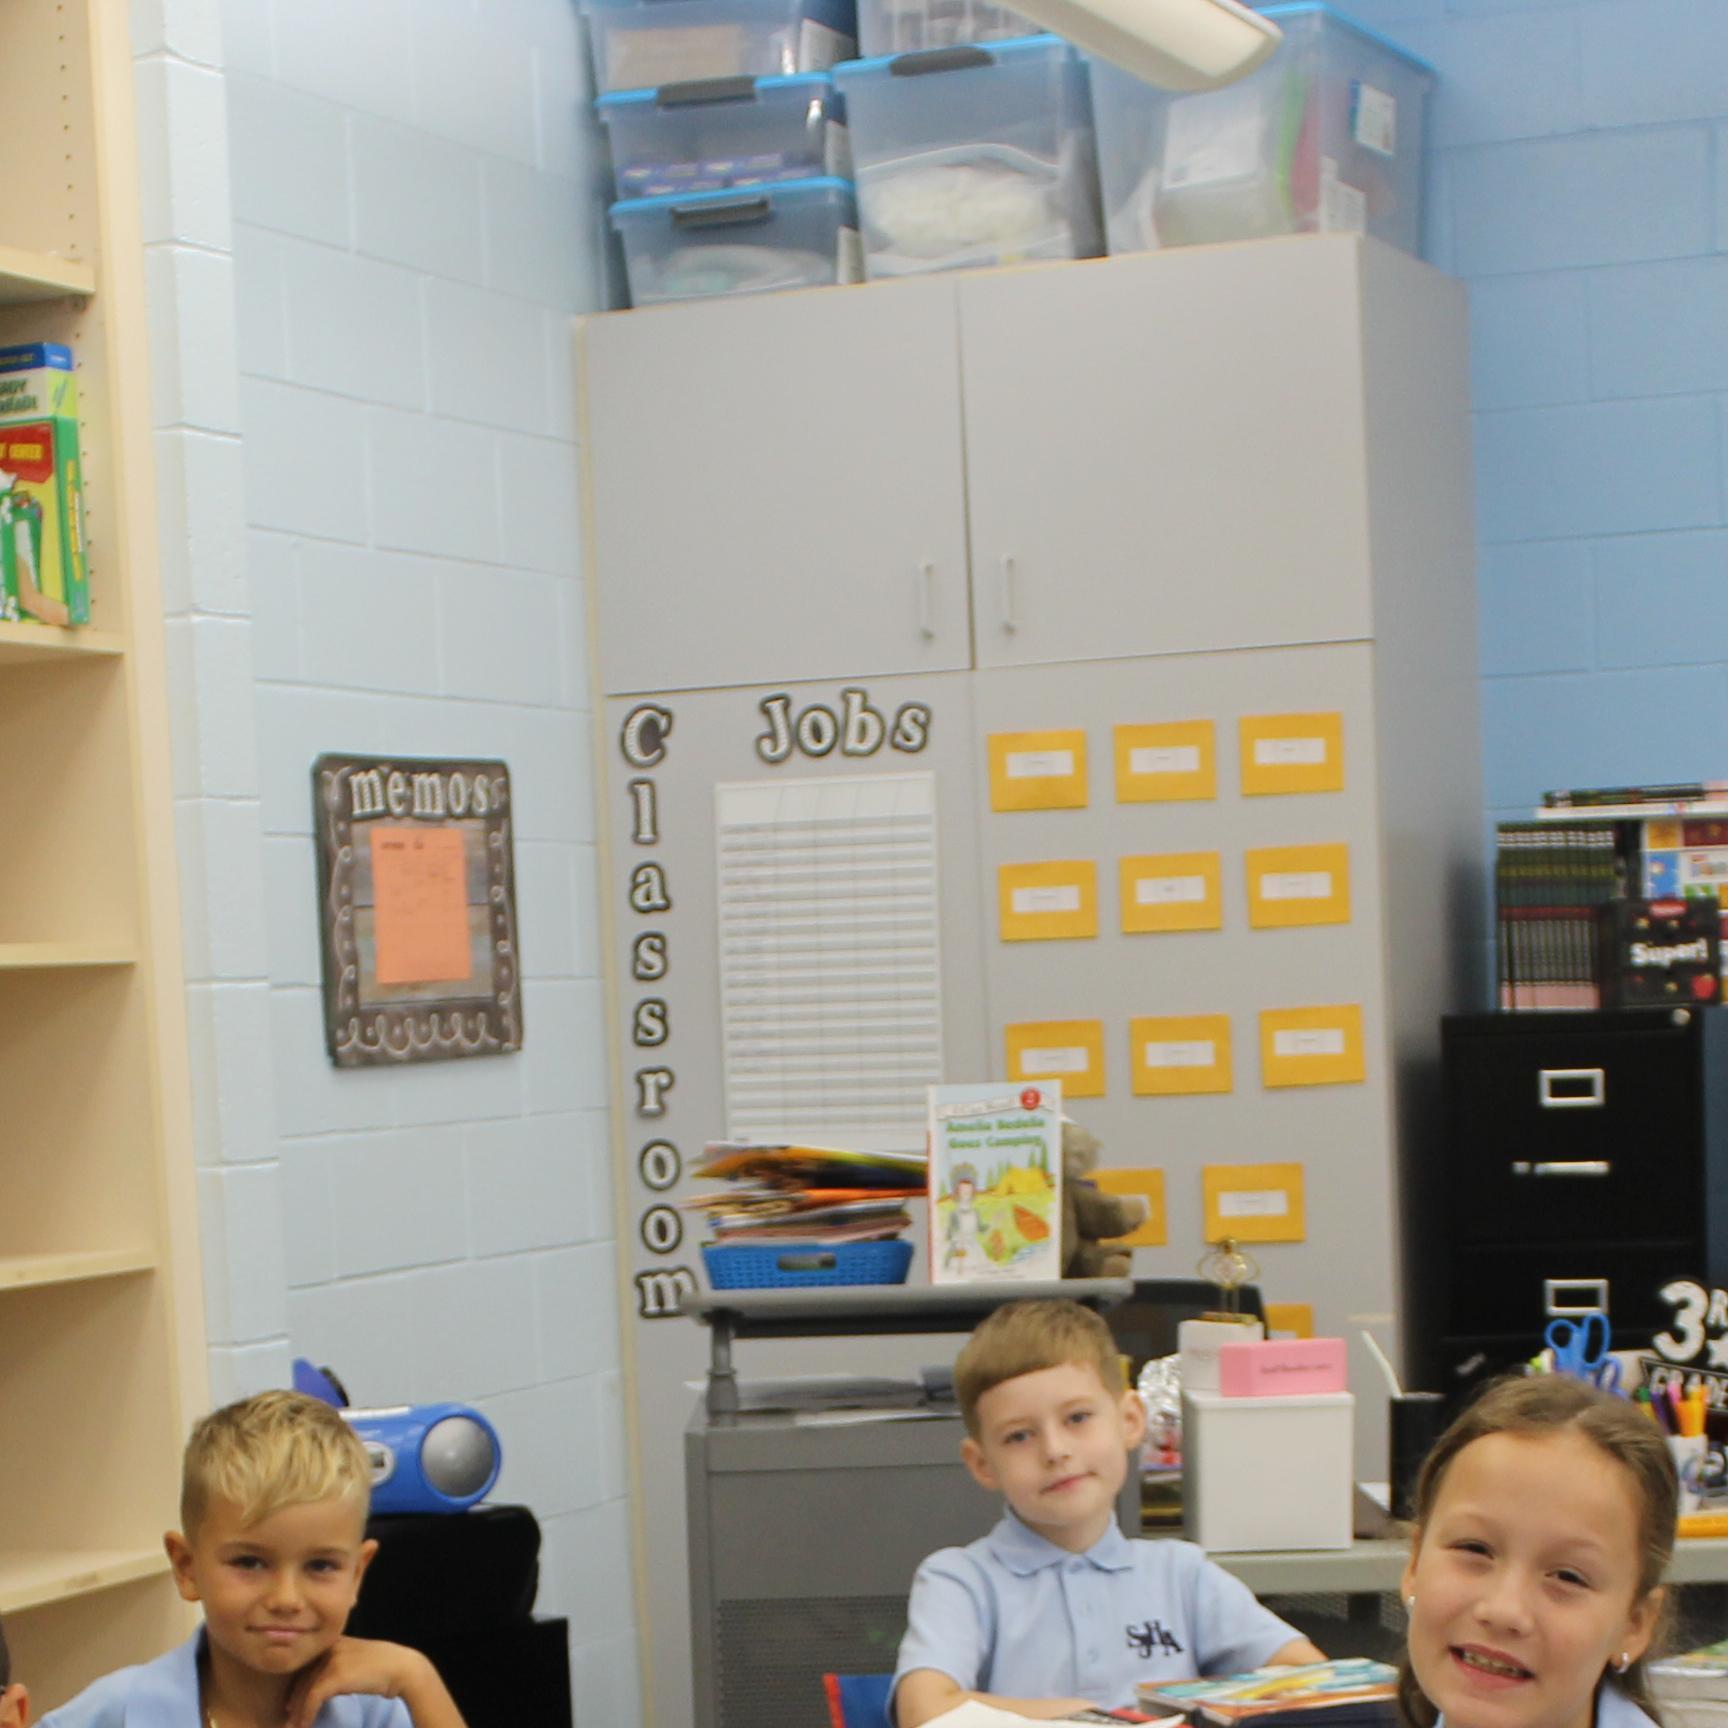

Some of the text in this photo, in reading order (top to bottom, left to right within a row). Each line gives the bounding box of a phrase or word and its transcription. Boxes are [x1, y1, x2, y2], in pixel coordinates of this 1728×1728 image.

[755, 687, 932, 766] Jobs
[348, 769, 493, 821] memos
[621, 702, 699, 1319] Classroom
